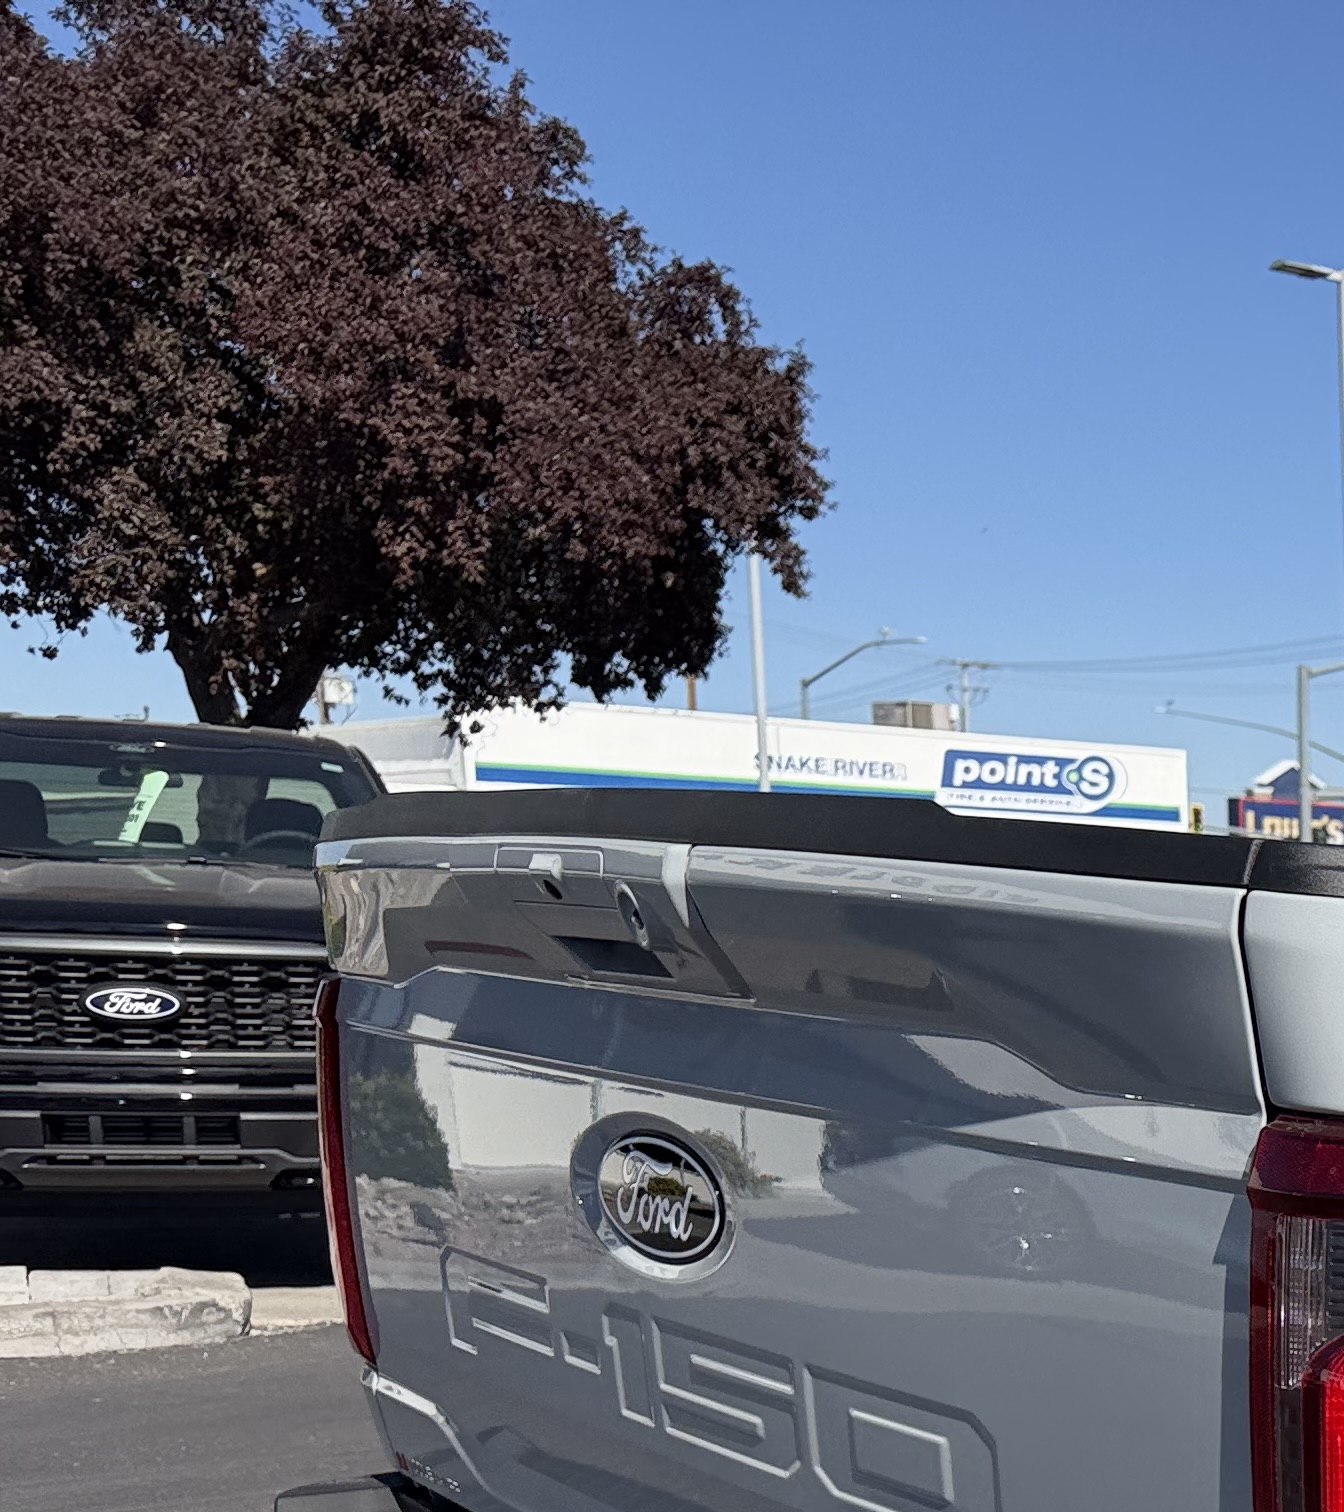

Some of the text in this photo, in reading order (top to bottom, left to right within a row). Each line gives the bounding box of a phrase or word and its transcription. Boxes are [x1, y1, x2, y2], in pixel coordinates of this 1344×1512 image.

[834, 758, 898, 781] RIVER
[953, 756, 1110, 796] point S
[103, 991, 163, 1015] Ford
[617, 1150, 694, 1242] Ford
